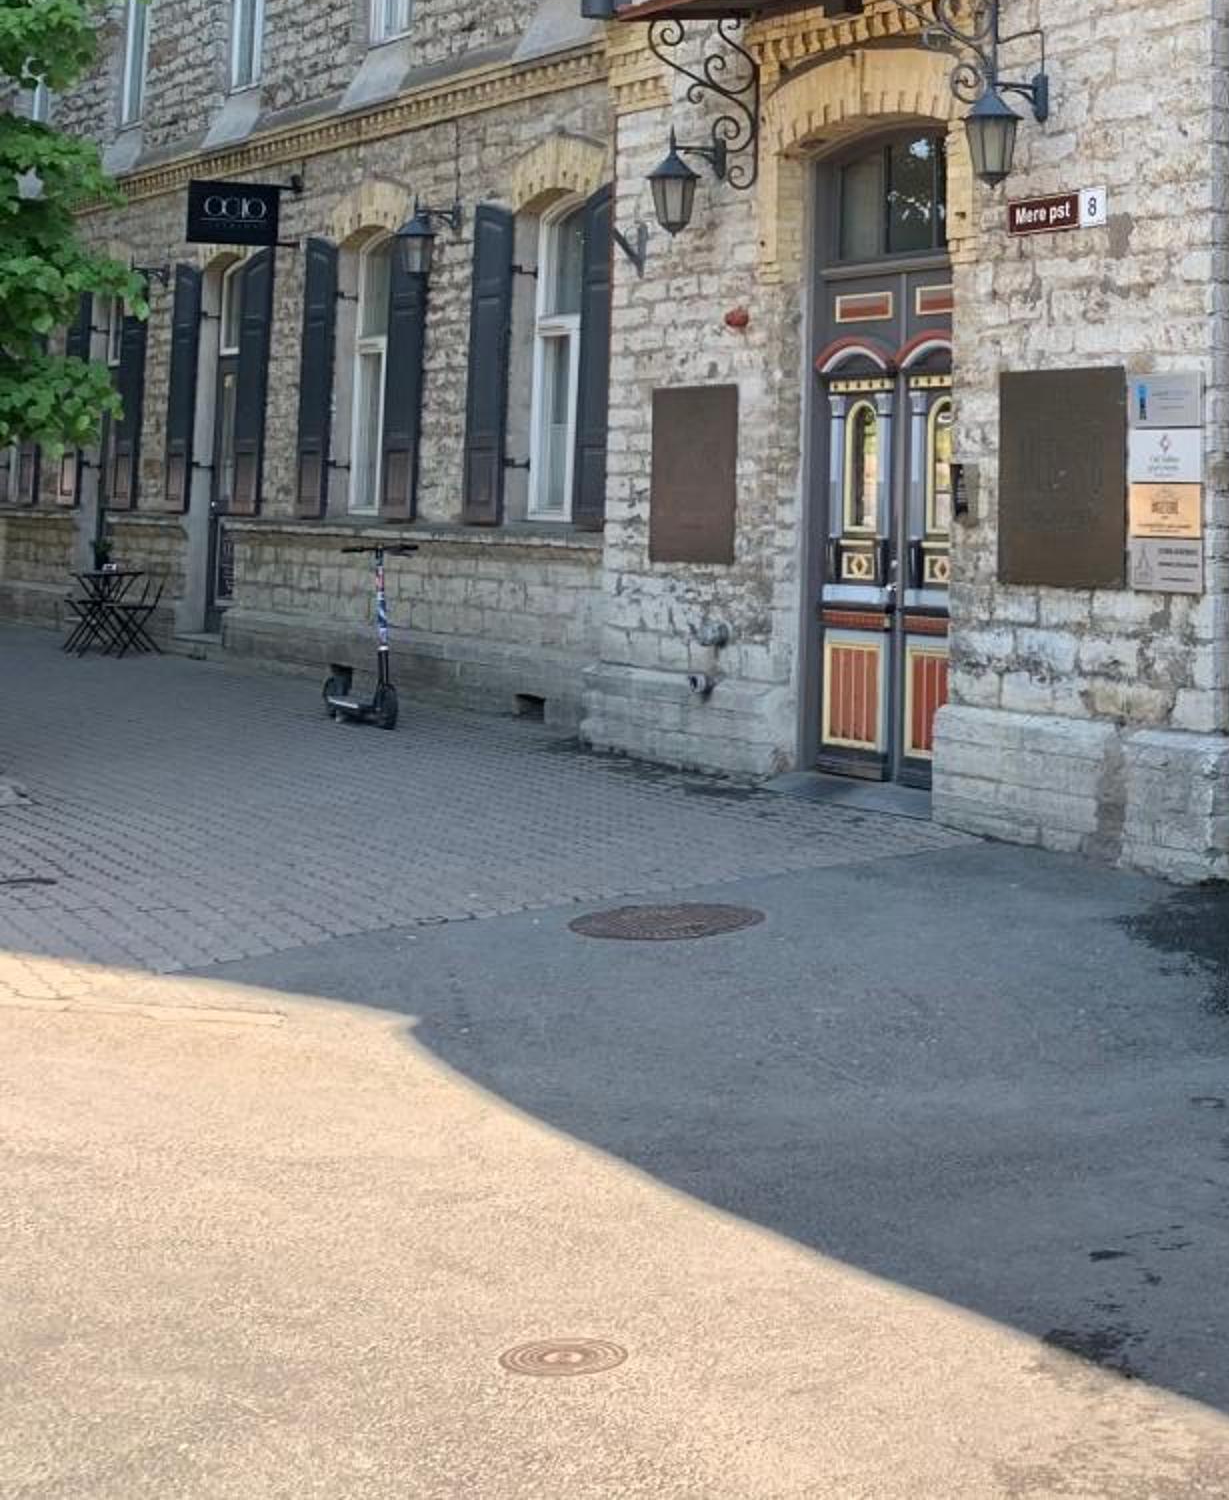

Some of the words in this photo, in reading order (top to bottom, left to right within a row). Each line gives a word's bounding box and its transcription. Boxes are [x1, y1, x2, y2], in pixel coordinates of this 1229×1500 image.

[1015, 207, 1047, 225] Mere
[1049, 202, 1070, 224] pst
[1088, 197, 1097, 216] 8
